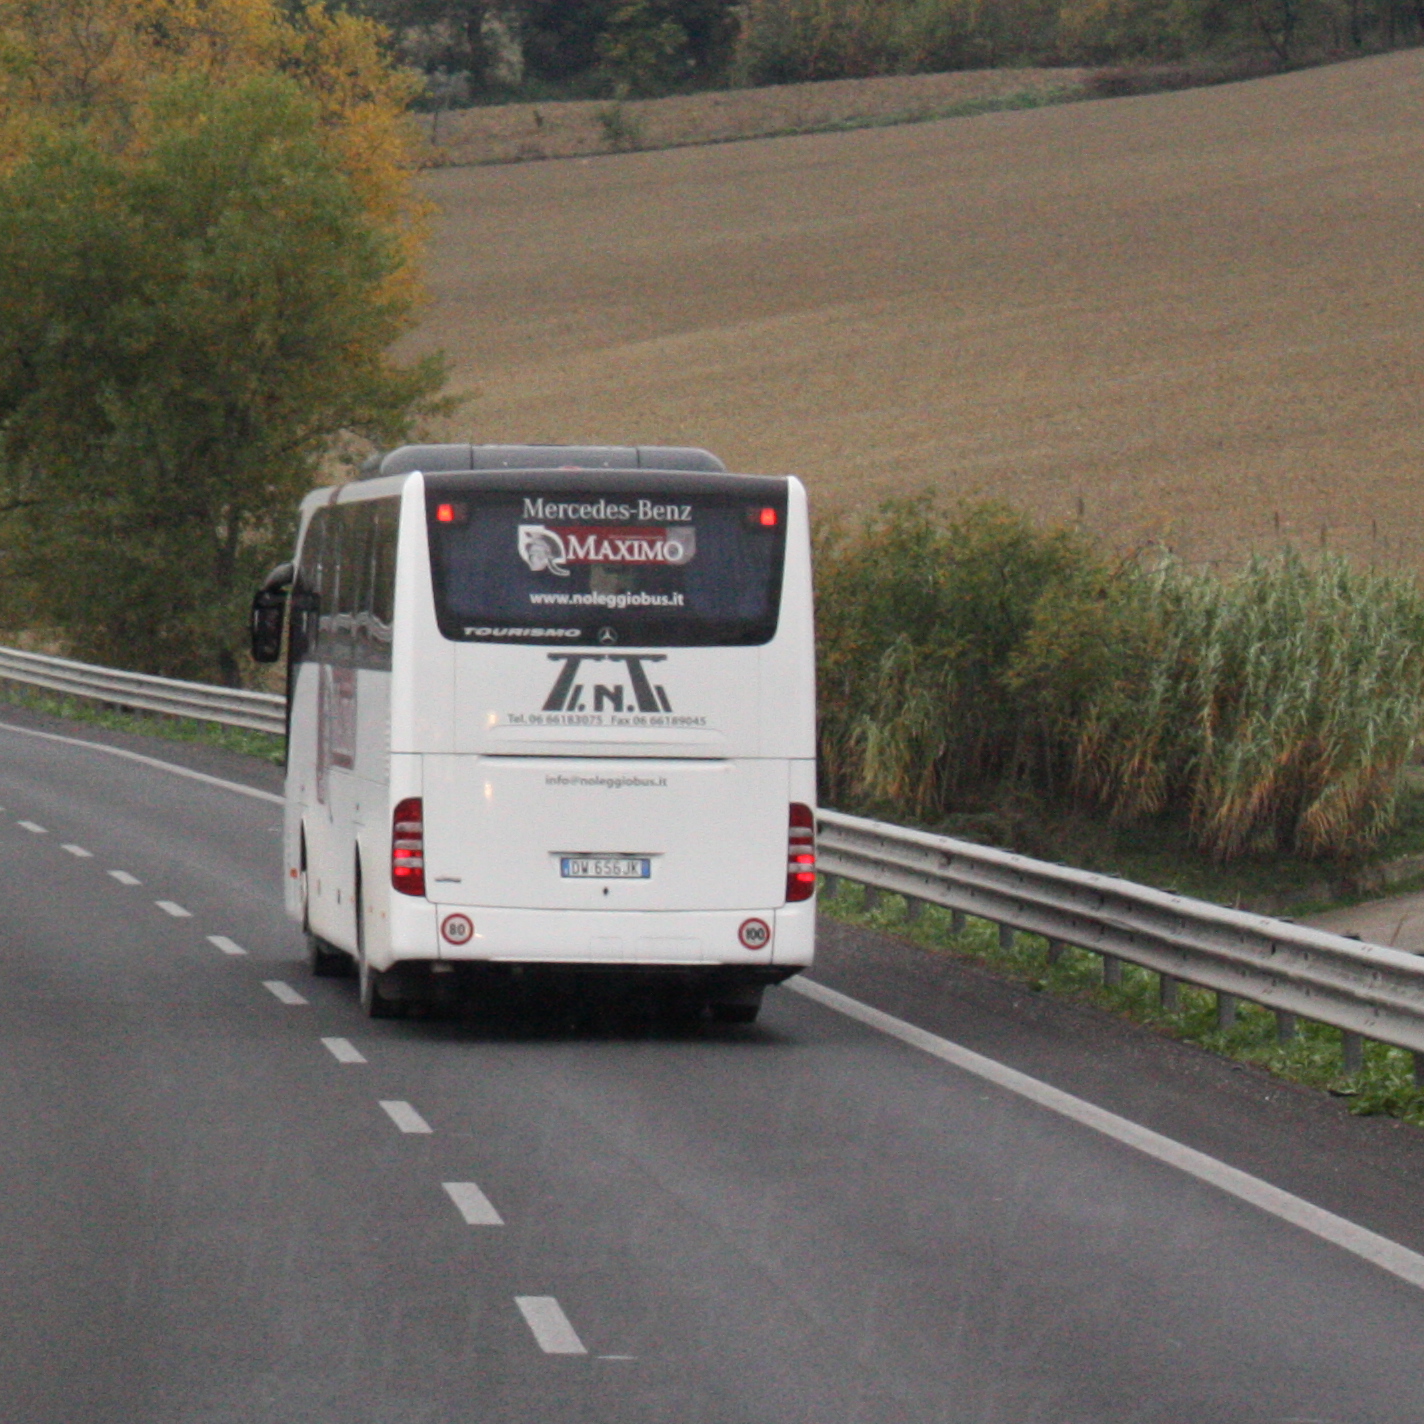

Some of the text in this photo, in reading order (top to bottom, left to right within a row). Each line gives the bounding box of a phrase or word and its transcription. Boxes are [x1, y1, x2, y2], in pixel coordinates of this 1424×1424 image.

[522, 497, 692, 521] Mercedes-Benz
[566, 534, 684, 562] MAXIMO
[529, 591, 684, 608] www.noleggiobus.it
[463, 627, 582, 638] TOURISMO
[508, 713, 527, 725] Tel.
[529, 713, 543, 725] 06
[611, 715, 630, 725] Fax
[633, 715, 647, 725] 06
[545, 775, 668, 788] info@noleggiobus.it
[449, 923, 465, 936] 80
[745, 927, 766, 941] 100
